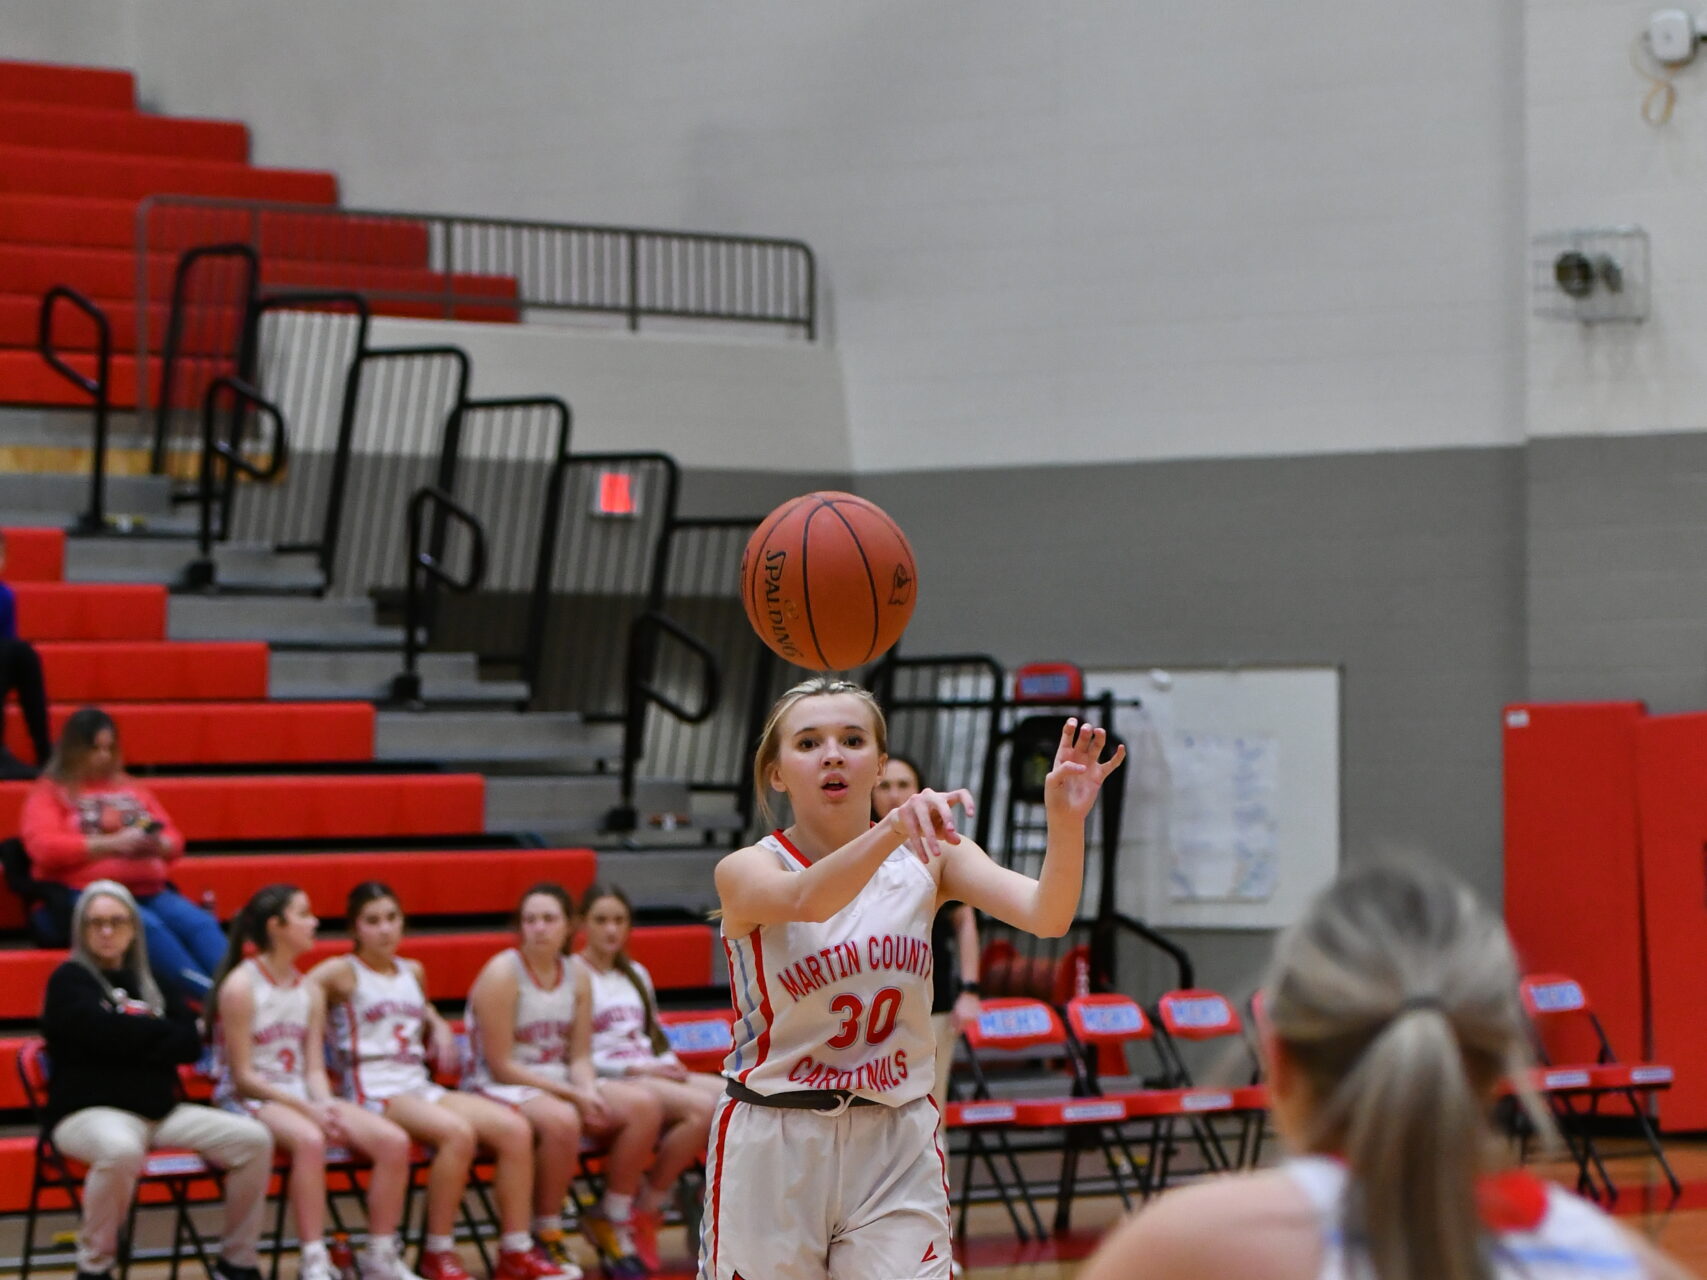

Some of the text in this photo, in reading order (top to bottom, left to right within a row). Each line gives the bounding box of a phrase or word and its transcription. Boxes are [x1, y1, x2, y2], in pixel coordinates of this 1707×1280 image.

[765, 550, 804, 657] SPALDING
[777, 940, 862, 1002] MARTIN
[826, 986, 904, 1049] 30
[787, 1048, 908, 1092] CARDINALS
